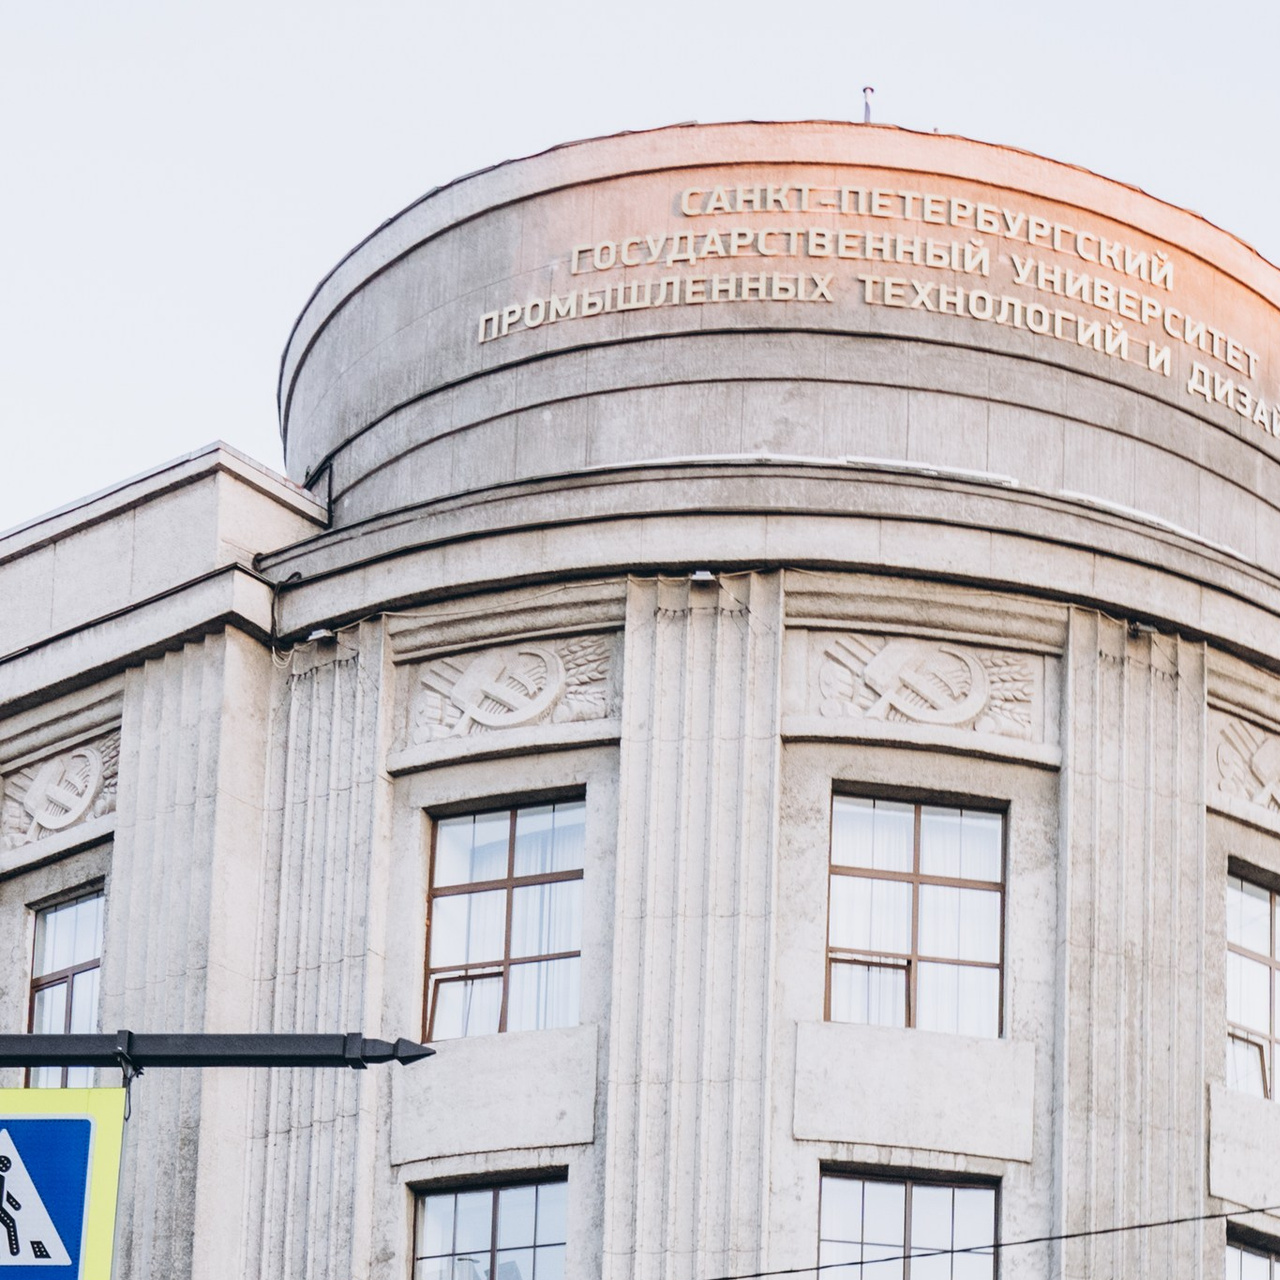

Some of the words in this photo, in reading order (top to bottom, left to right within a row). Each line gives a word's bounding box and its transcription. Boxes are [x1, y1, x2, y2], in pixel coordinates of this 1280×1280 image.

[680, 182, 1174, 290] САНКТ-ПЕТЕРБУРГСКИЙ
[478, 272, 834, 343] ПРОМЫШЛЕННЫХ
[858, 274, 1130, 361] ТЕХНОЛОГИЙ
[1147, 340, 1172, 377] И
[571, 226, 990, 277] ГОСУДАРСТВЕННЫЙ
[1011, 254, 1260, 379] УНИВЕРСИТЕТ
